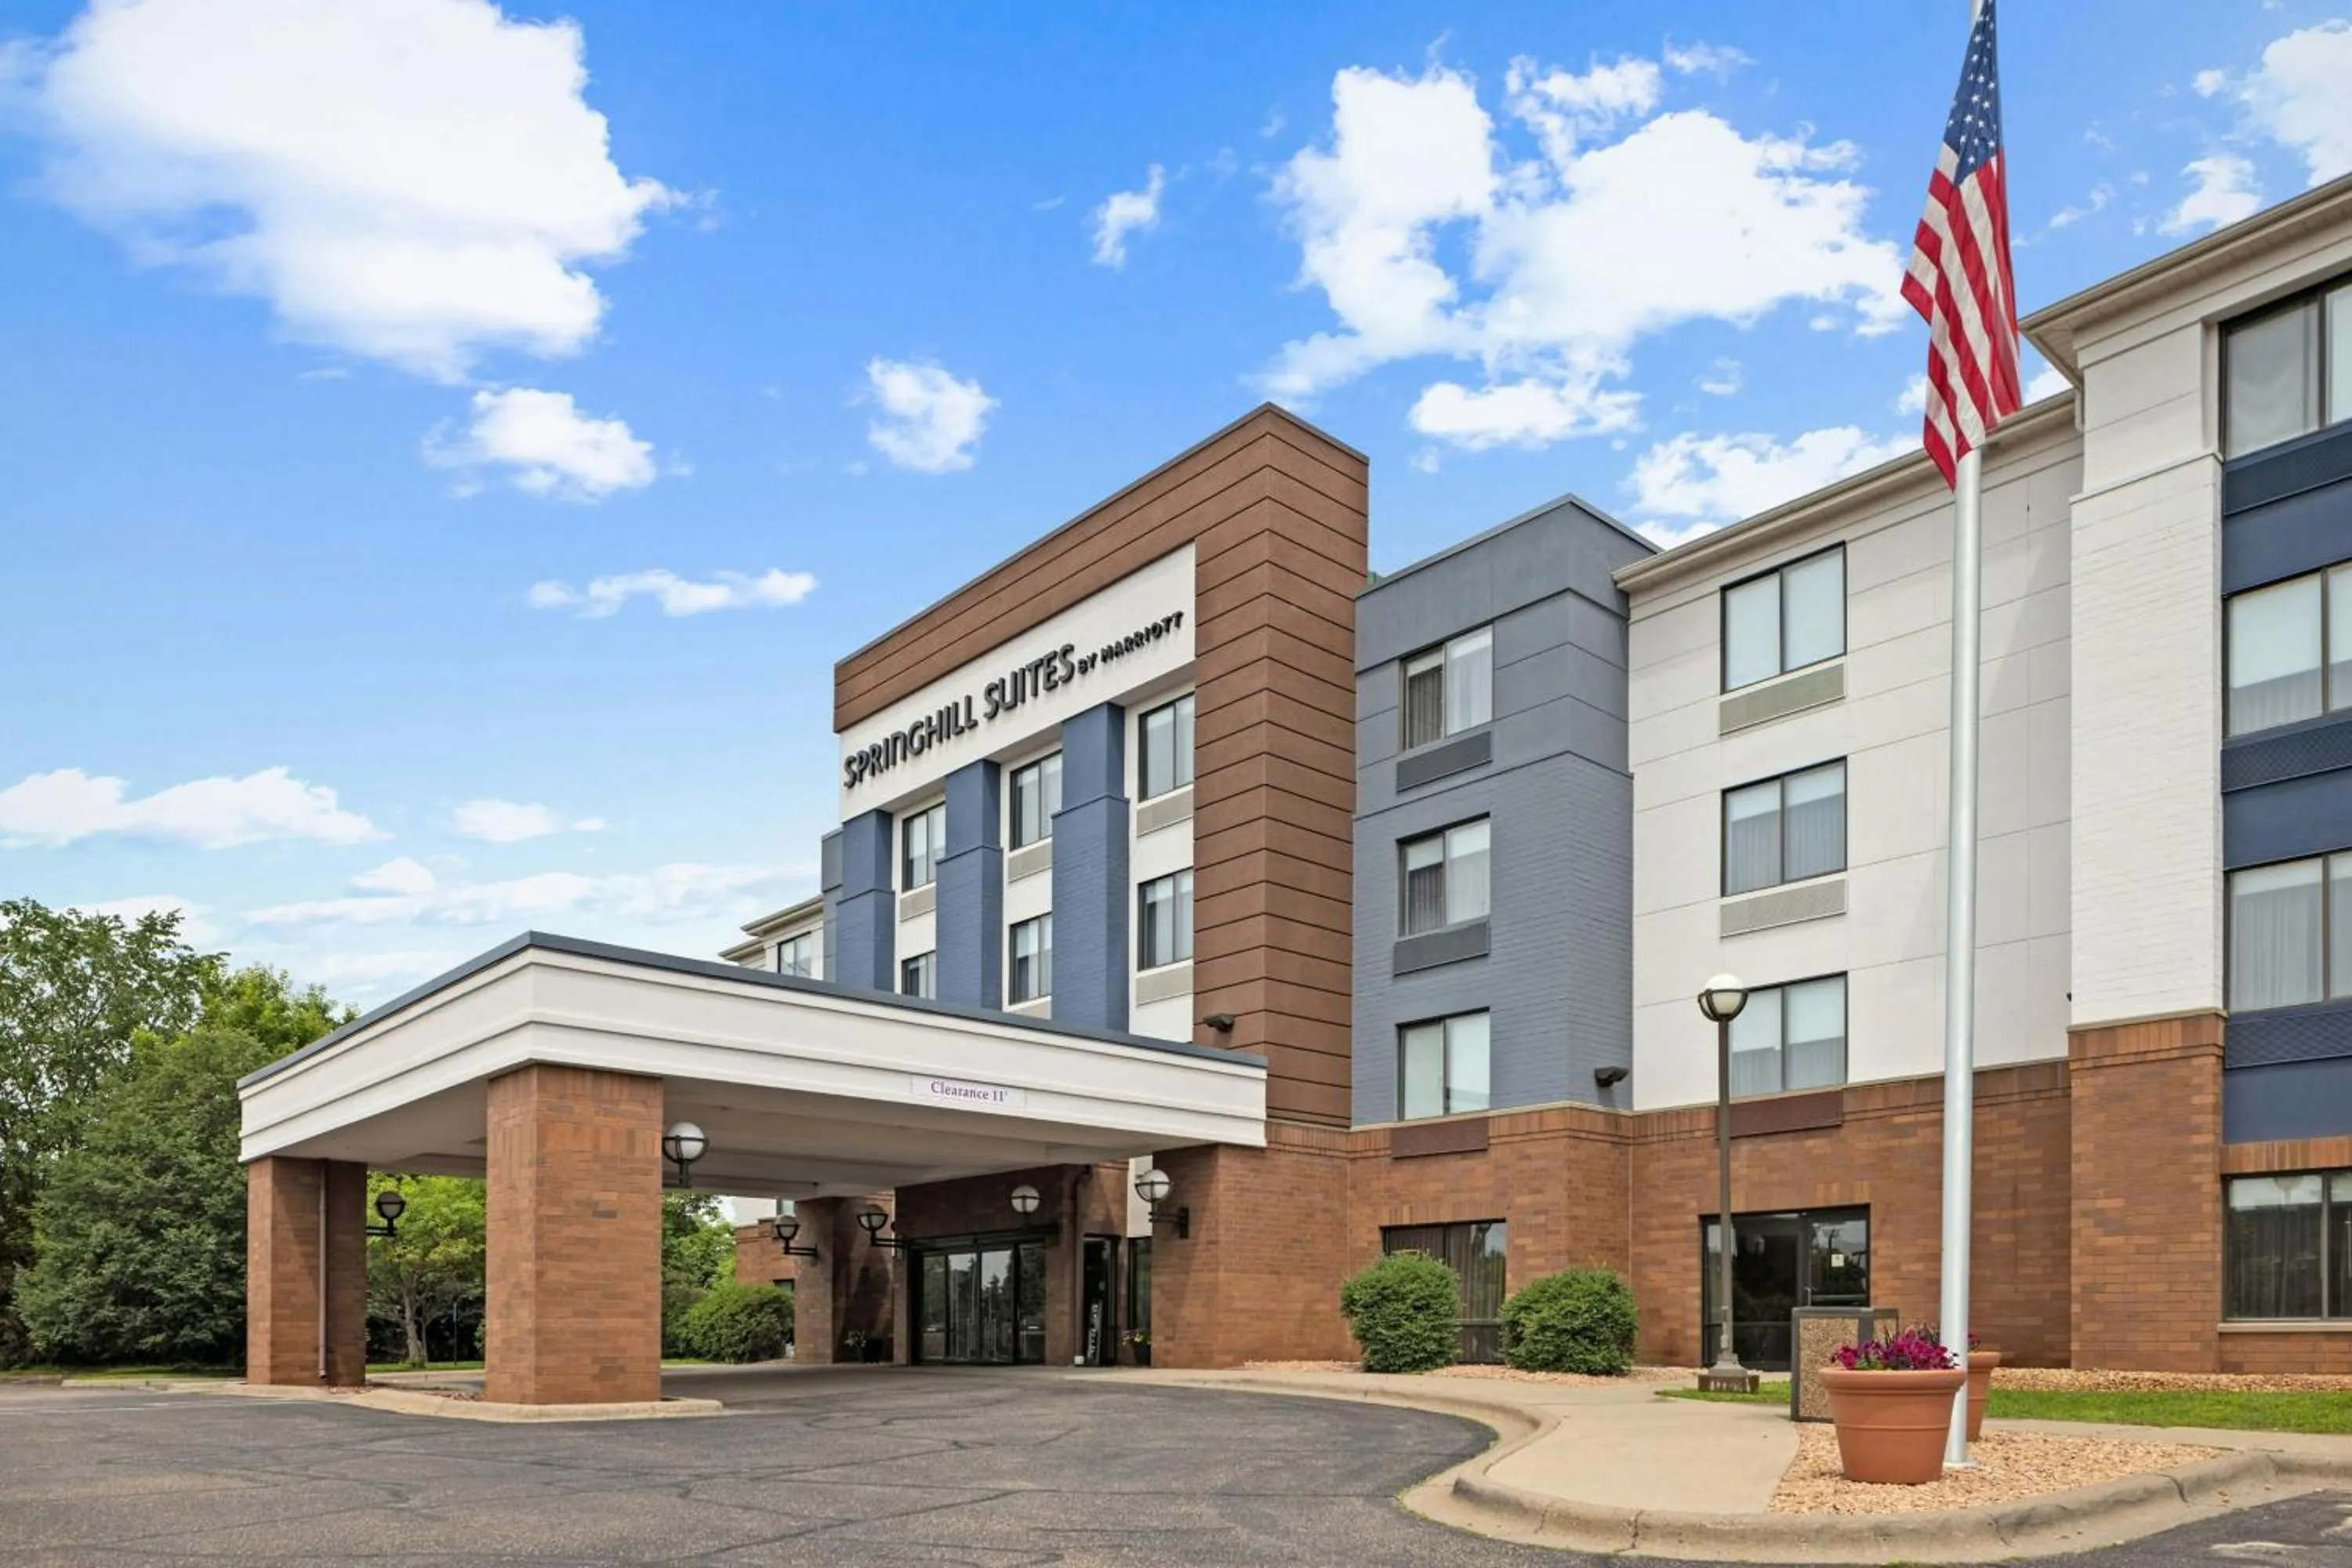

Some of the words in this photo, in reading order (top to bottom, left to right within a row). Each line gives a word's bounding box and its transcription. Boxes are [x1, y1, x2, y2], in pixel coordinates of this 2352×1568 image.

[844, 695, 978, 789] SPRINGHILL
[983, 644, 1075, 720] SUITES
[1078, 652, 1098, 674] BY
[1101, 611, 1184, 663] MARRIOTT
[931, 1080, 989, 1100] Clearance
